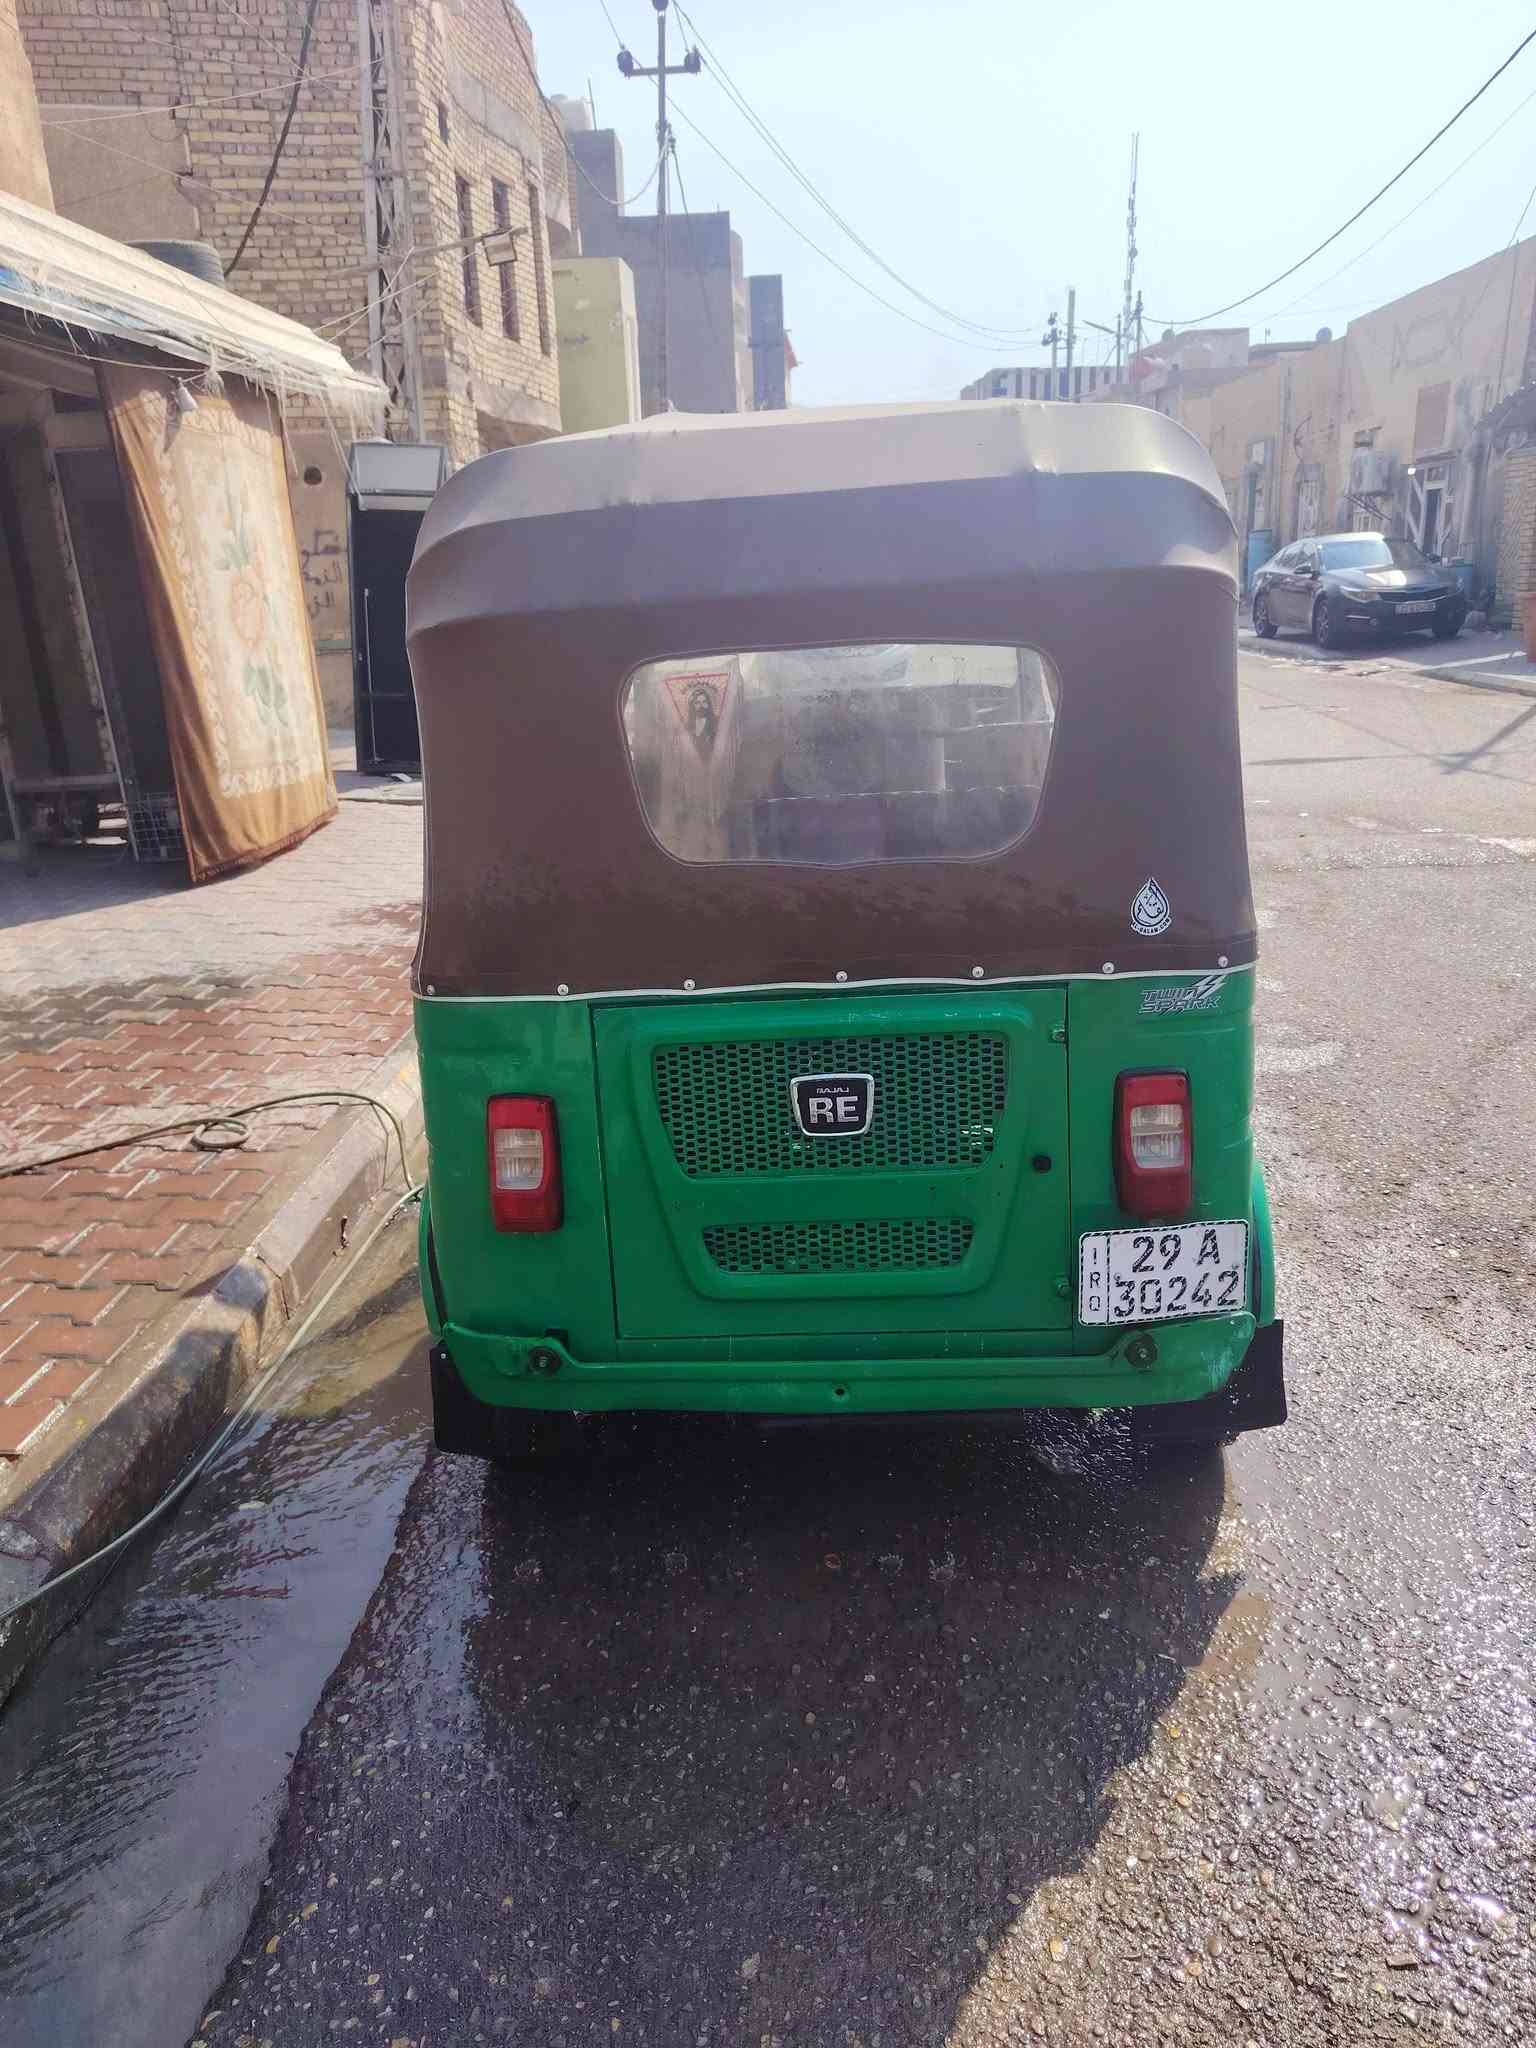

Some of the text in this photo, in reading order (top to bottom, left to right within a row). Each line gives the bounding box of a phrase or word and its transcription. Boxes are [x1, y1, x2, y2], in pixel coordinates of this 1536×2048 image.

[1138, 996, 1221, 1016] SPARK
[1141, 987, 1200, 1001] TWIN
[809, 1096, 859, 1123] RE
[1132, 1229, 1220, 1272] 29 A
[1114, 1269, 1239, 1317] 30242
